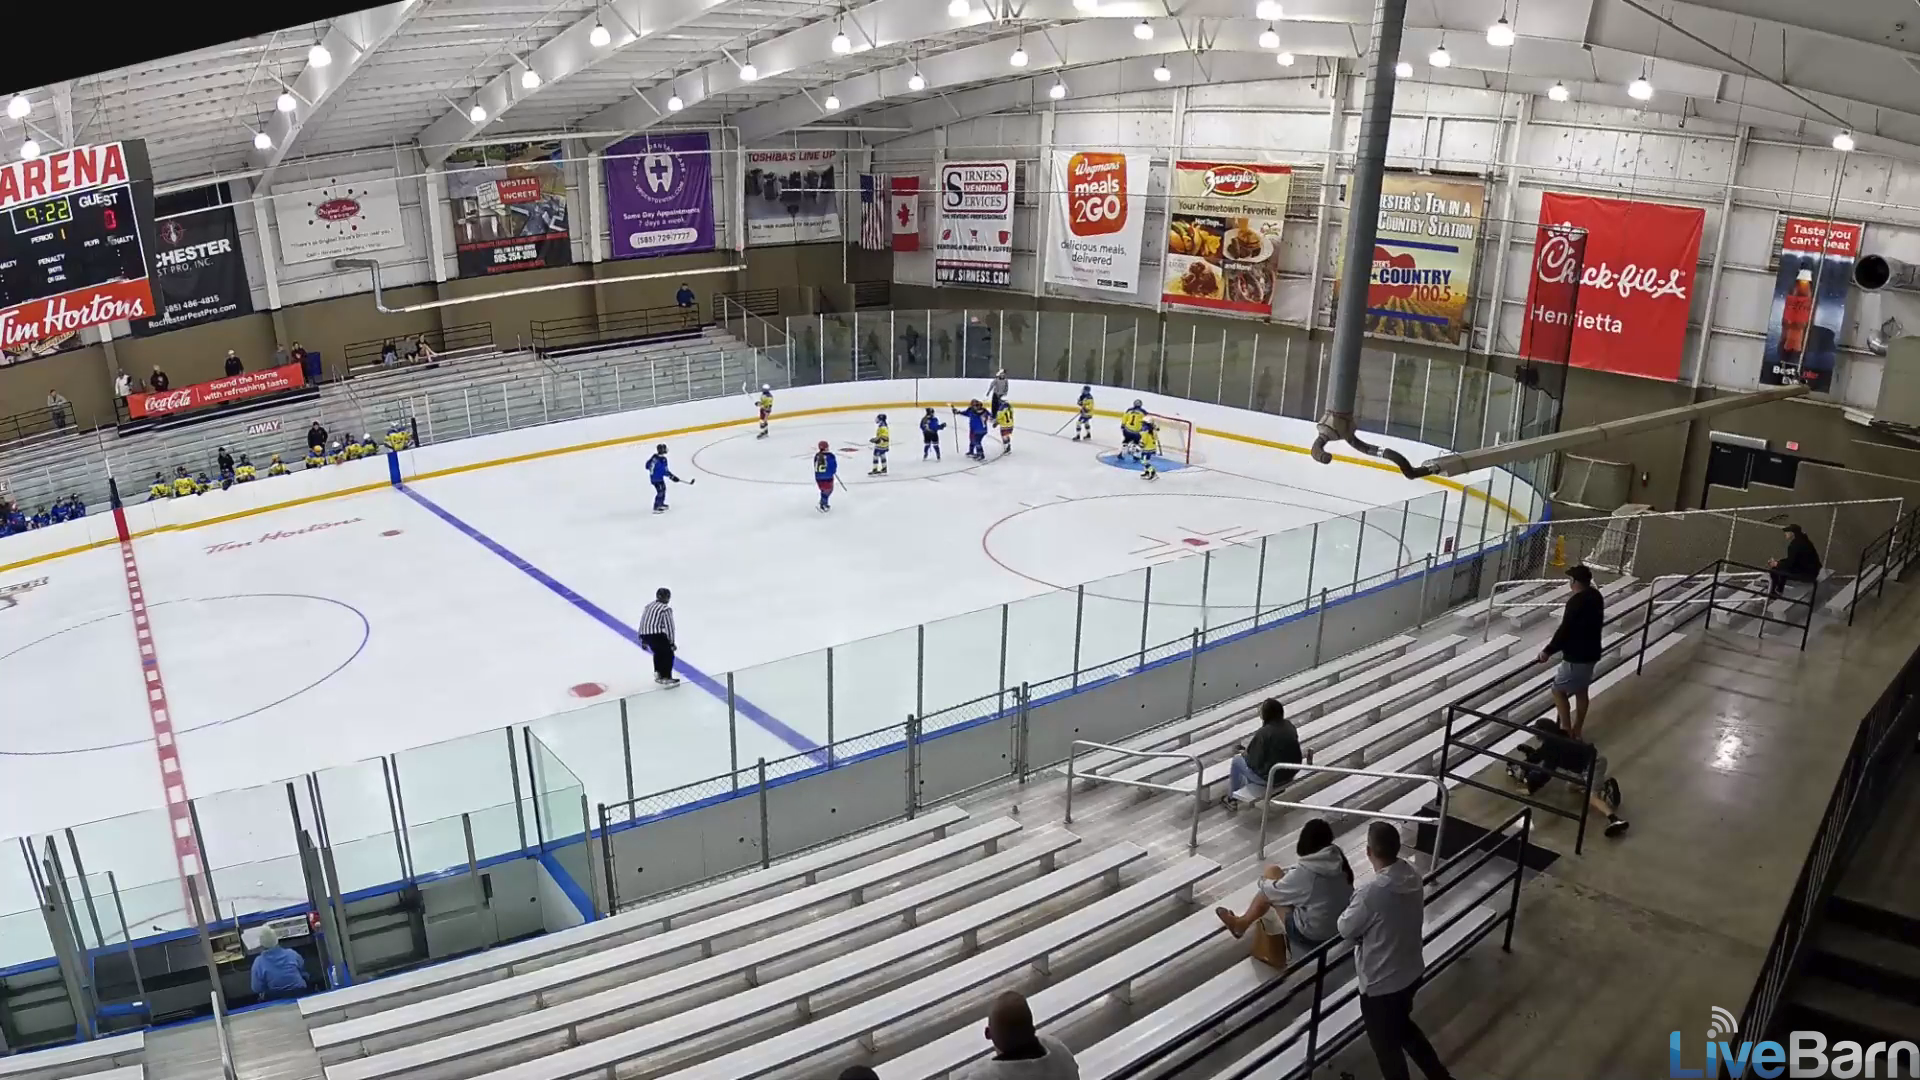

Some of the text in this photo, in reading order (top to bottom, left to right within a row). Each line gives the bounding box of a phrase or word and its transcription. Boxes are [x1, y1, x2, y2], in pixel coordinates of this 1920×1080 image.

[748, 149, 836, 163] TOSHIBA'S LINE UP
[0, 144, 126, 207] ARENA
[1075, 157, 1121, 181] Wegmans
[500, 177, 536, 189] UPSTATE
[965, 183, 1003, 193] VENDING
[1075, 173, 1120, 198] meals
[78, 193, 119, 208] GUEST
[503, 189, 538, 201] INCRETE
[25, 200, 69, 225] 9:22
[1074, 195, 1121, 224] 2GO
[1178, 200, 1196, 211] Your
[1197, 203, 1240, 214] Hometown
[1448, 200, 1461, 216] IN
[1463, 201, 1471, 217] A
[642, 211, 656, 219] Day
[1377, 210, 1475, 240] COUNTRY STATION
[1794, 224, 1852, 240] Taste you
[31, 232, 54, 244] PERIOD
[1790, 236, 1851, 250] can't beat
[1060, 240, 1127, 256] delicious meals,
[38, 254, 65, 266] PENALTY
[1071, 252, 1113, 266] delivered
[1380, 268, 1452, 285] COUNTRY
[1414, 285, 1452, 302] 100.5
[0, 309, 40, 346] Tim
[210, 371, 278, 390] Sound the horns
[203, 378, 288, 401] with refreshing taste
[248, 421, 279, 434] AWAY
[1130, 414, 1137, 426] 1
[202, 541, 252, 556] Tim
